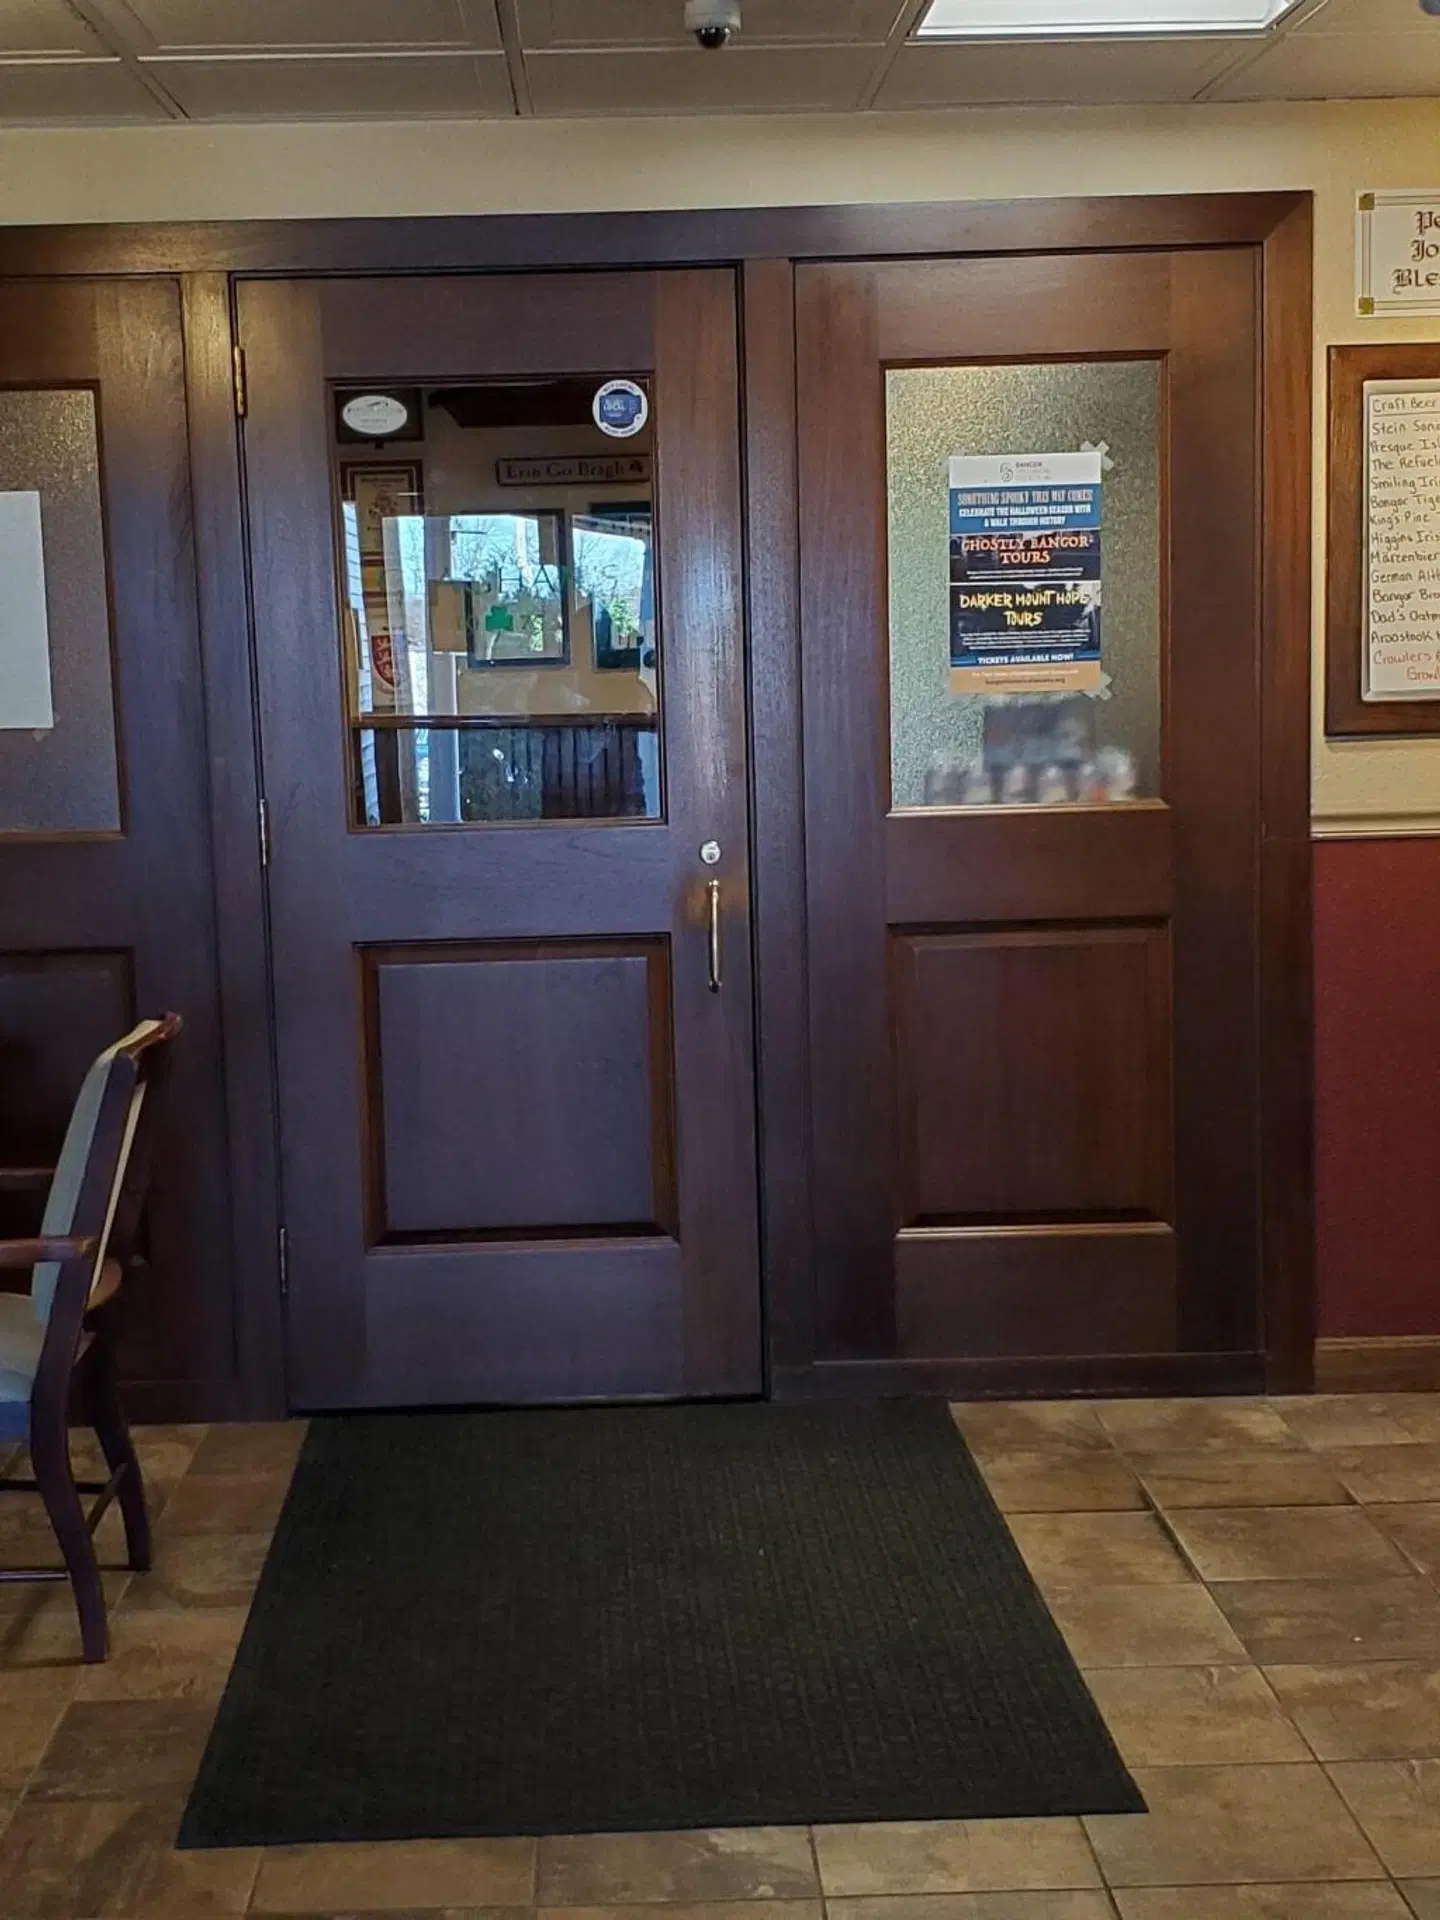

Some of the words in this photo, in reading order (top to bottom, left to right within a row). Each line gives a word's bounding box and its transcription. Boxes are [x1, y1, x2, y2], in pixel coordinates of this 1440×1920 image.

[1372, 397, 1406, 414] Craft
[1410, 396, 1436, 409] Beer
[1372, 421, 1406, 436] Stein
[1370, 439, 1414, 456] Presque
[1372, 458, 1395, 472] The
[1371, 475, 1416, 494] Smiling
[996, 507, 1009, 517] THE
[1010, 505, 1048, 516] HALLOWEEN
[1074, 503, 1092, 514] WITH
[1370, 495, 1408, 514] Bangor
[983, 518, 990, 528] A
[990, 517, 1008, 527] WALK
[1369, 512, 1401, 530] King's
[1404, 510, 1431, 525] Pine
[961, 537, 1025, 552] GHOSTLY
[1031, 535, 1089, 550] BANGOR
[1371, 532, 1413, 551] Higgins
[1000, 551, 1050, 564] TOURS
[1372, 569, 1413, 584] German
[960, 592, 1013, 610] DARKER
[1016, 590, 1056, 607] MOUNT
[1056, 590, 1090, 605] HOPE
[1372, 589, 1417, 609] Bangor
[1004, 611, 1044, 627] TOURS
[1371, 608, 1406, 624] Dad's
[1371, 630, 1436, 644] Aroostook
[978, 656, 1008, 665] TICKETS
[1010, 654, 1049, 664] AVAILABLE
[1051, 653, 1074, 662] NOW!
[1374, 649, 1433, 665] Crowlers
